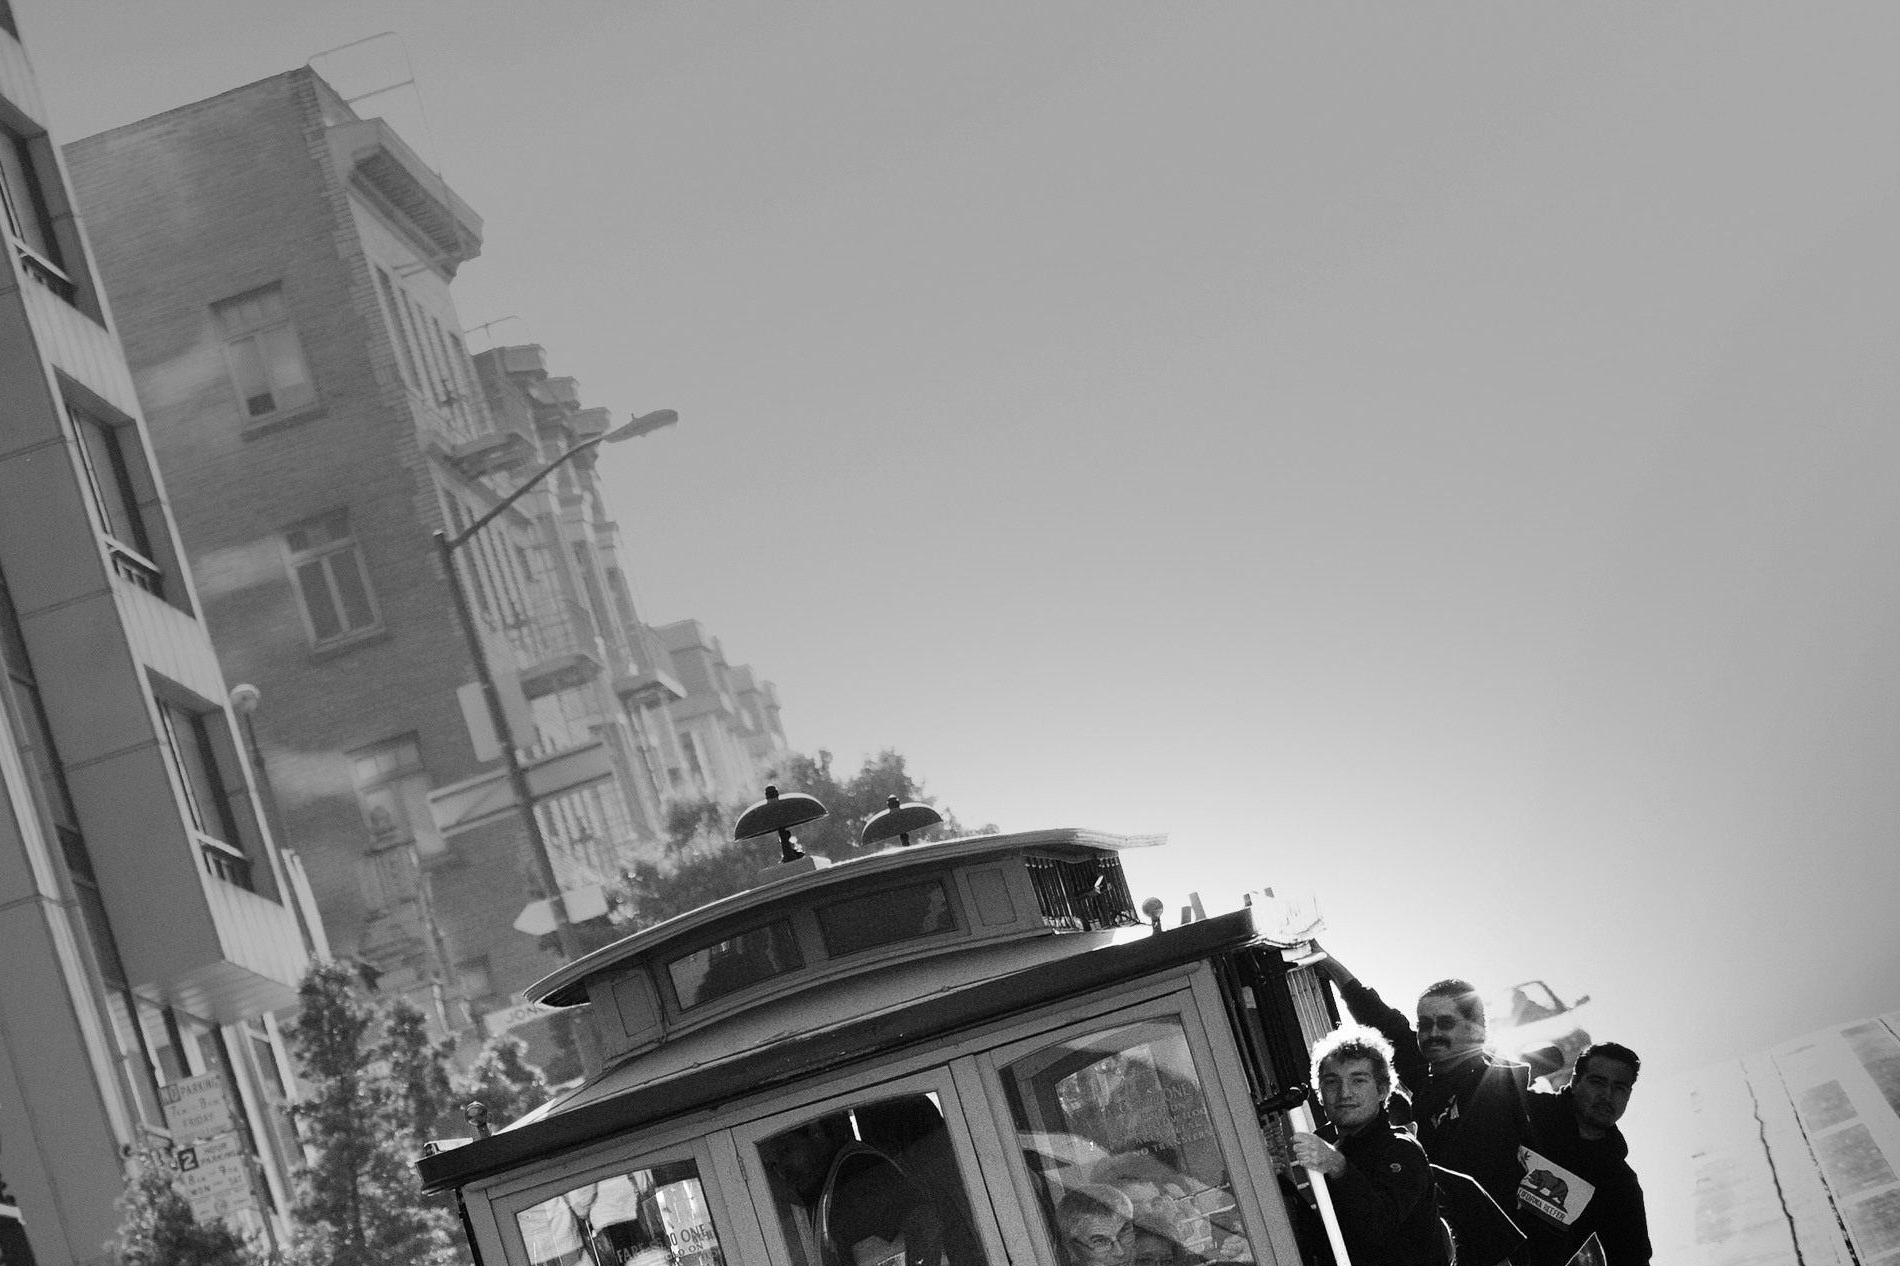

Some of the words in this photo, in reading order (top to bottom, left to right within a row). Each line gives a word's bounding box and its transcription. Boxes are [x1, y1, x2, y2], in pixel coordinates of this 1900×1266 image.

[503, 1005, 546, 1023] JON
[180, 1078, 219, 1096] PARKING
[182, 1112, 213, 1129] FRIDAY
[181, 1152, 196, 1170] 2
[1542, 1204, 1566, 1220] REEFER
[680, 1223, 707, 1243] ONE
